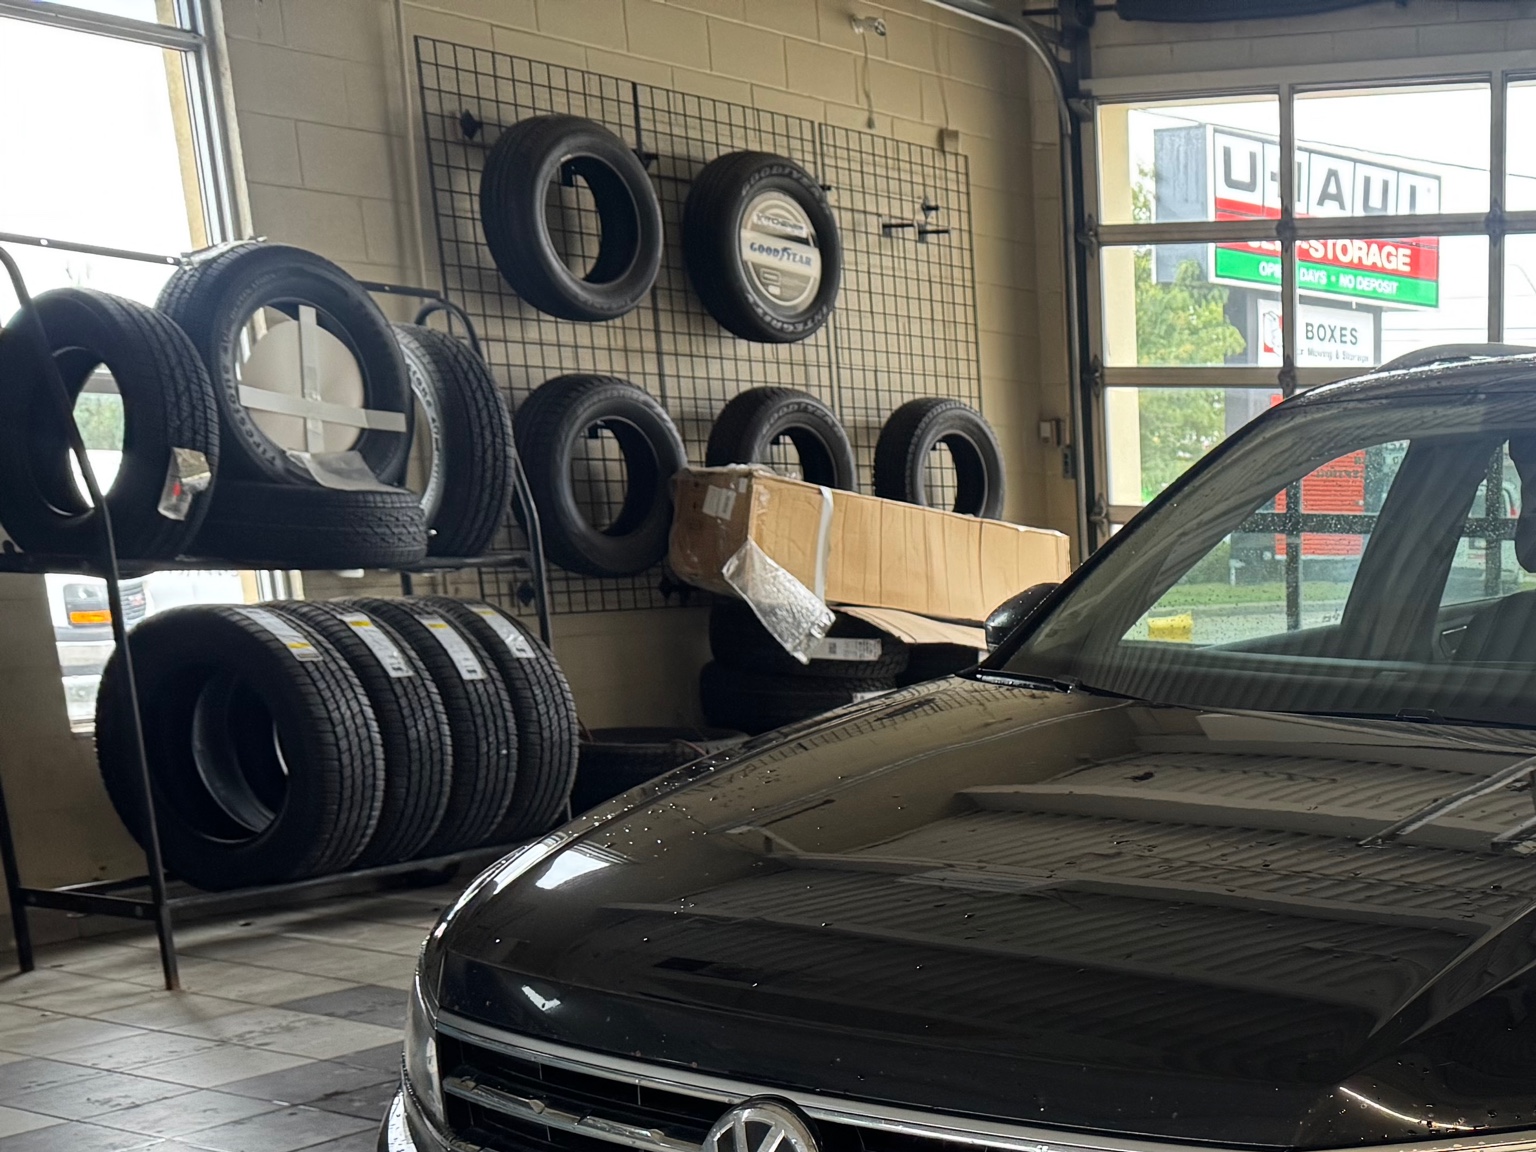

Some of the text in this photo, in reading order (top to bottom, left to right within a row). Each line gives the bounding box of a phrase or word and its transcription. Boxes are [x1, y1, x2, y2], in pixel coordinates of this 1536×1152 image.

[750, 241, 812, 266] GOODYEAR
[1300, 268, 1327, 284] DAYS
[1339, 273, 1354, 288] NO
[1356, 276, 1398, 296] DEPOSIT
[1305, 322, 1358, 346] BOXES
